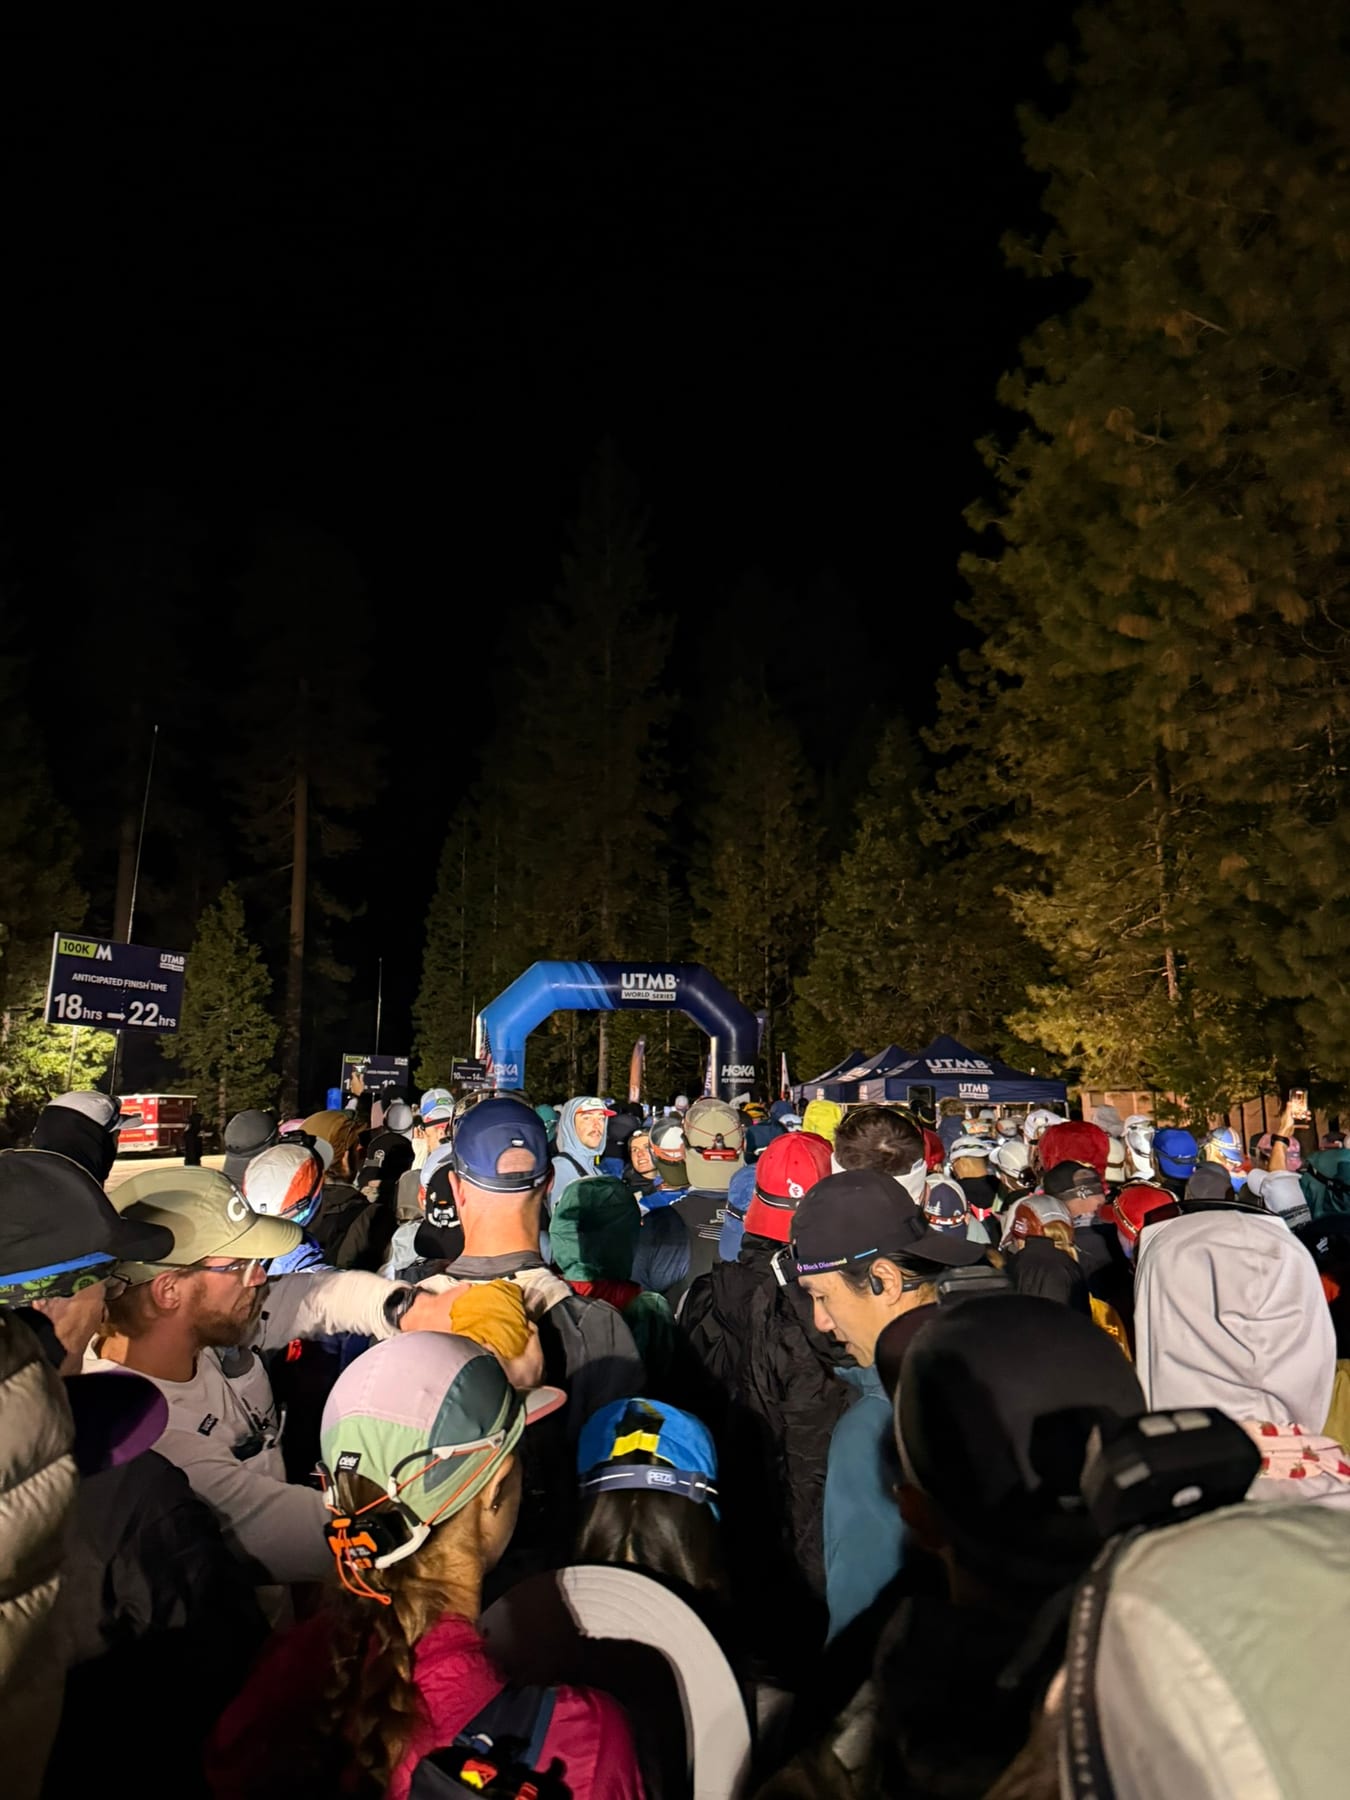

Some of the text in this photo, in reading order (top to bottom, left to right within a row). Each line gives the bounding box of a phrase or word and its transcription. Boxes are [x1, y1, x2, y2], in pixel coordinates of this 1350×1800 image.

[63, 941, 90, 954] 100K
[160, 953, 185, 965] UTMB
[72, 972, 168, 992] ANTICIPATED FINISH TIME
[621, 973, 677, 990] UTMB
[494, 1063, 518, 1077] OKA
[925, 1058, 989, 1069] UTMB
[721, 1064, 755, 1077] HOKA
[959, 1083, 989, 1093] UTMB
[803, 1263, 818, 1271] Black
